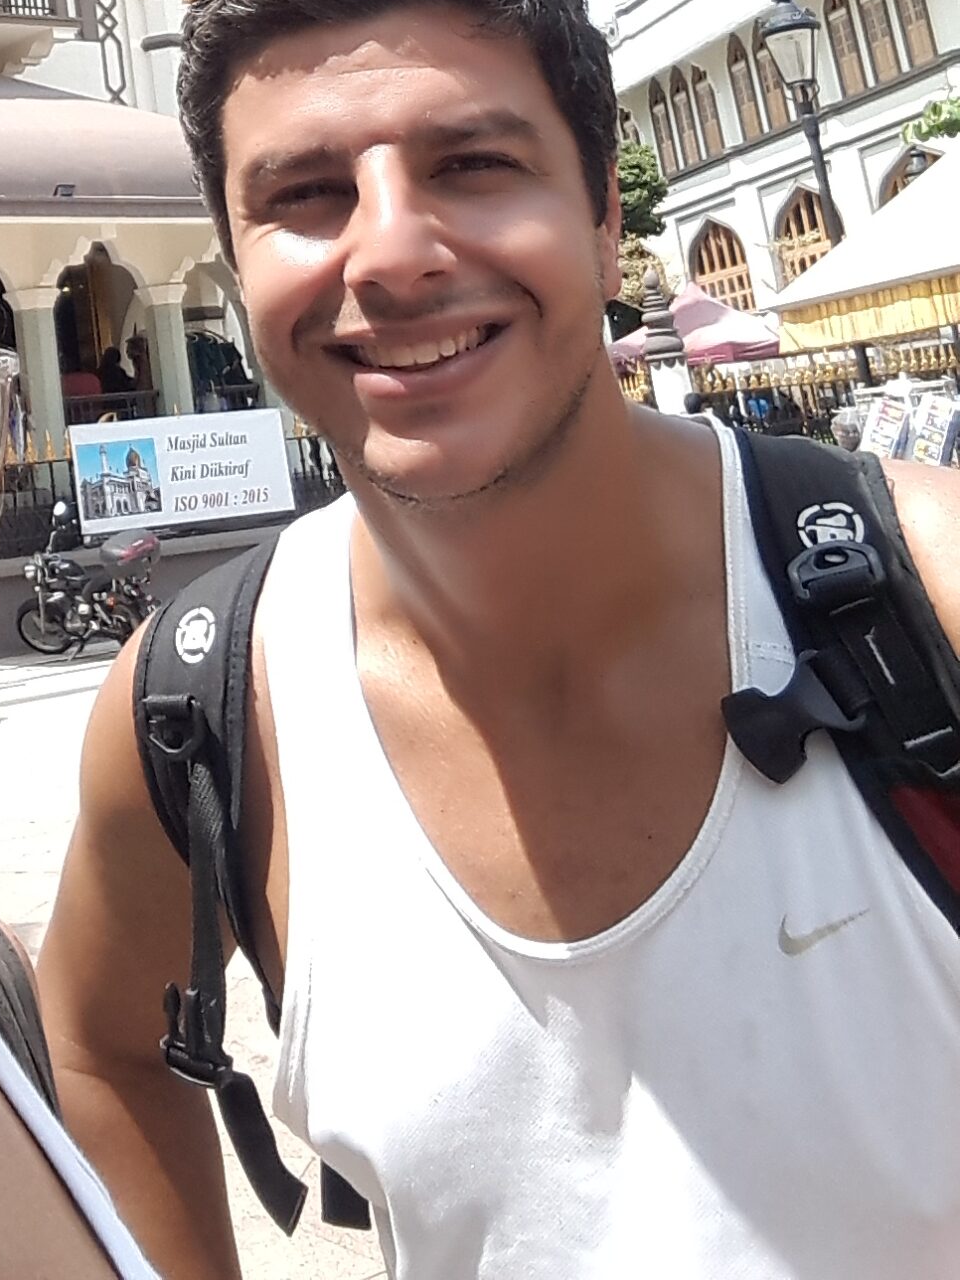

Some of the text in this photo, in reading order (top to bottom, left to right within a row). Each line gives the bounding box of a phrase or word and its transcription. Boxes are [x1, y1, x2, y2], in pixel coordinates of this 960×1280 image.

[167, 432, 247, 453] Masjid Sultan
[171, 459, 252, 482] Kini Diiktiraf
[174, 495, 199, 512] ISO
[202, 492, 229, 508] 9001
[242, 487, 269, 504] 2015
